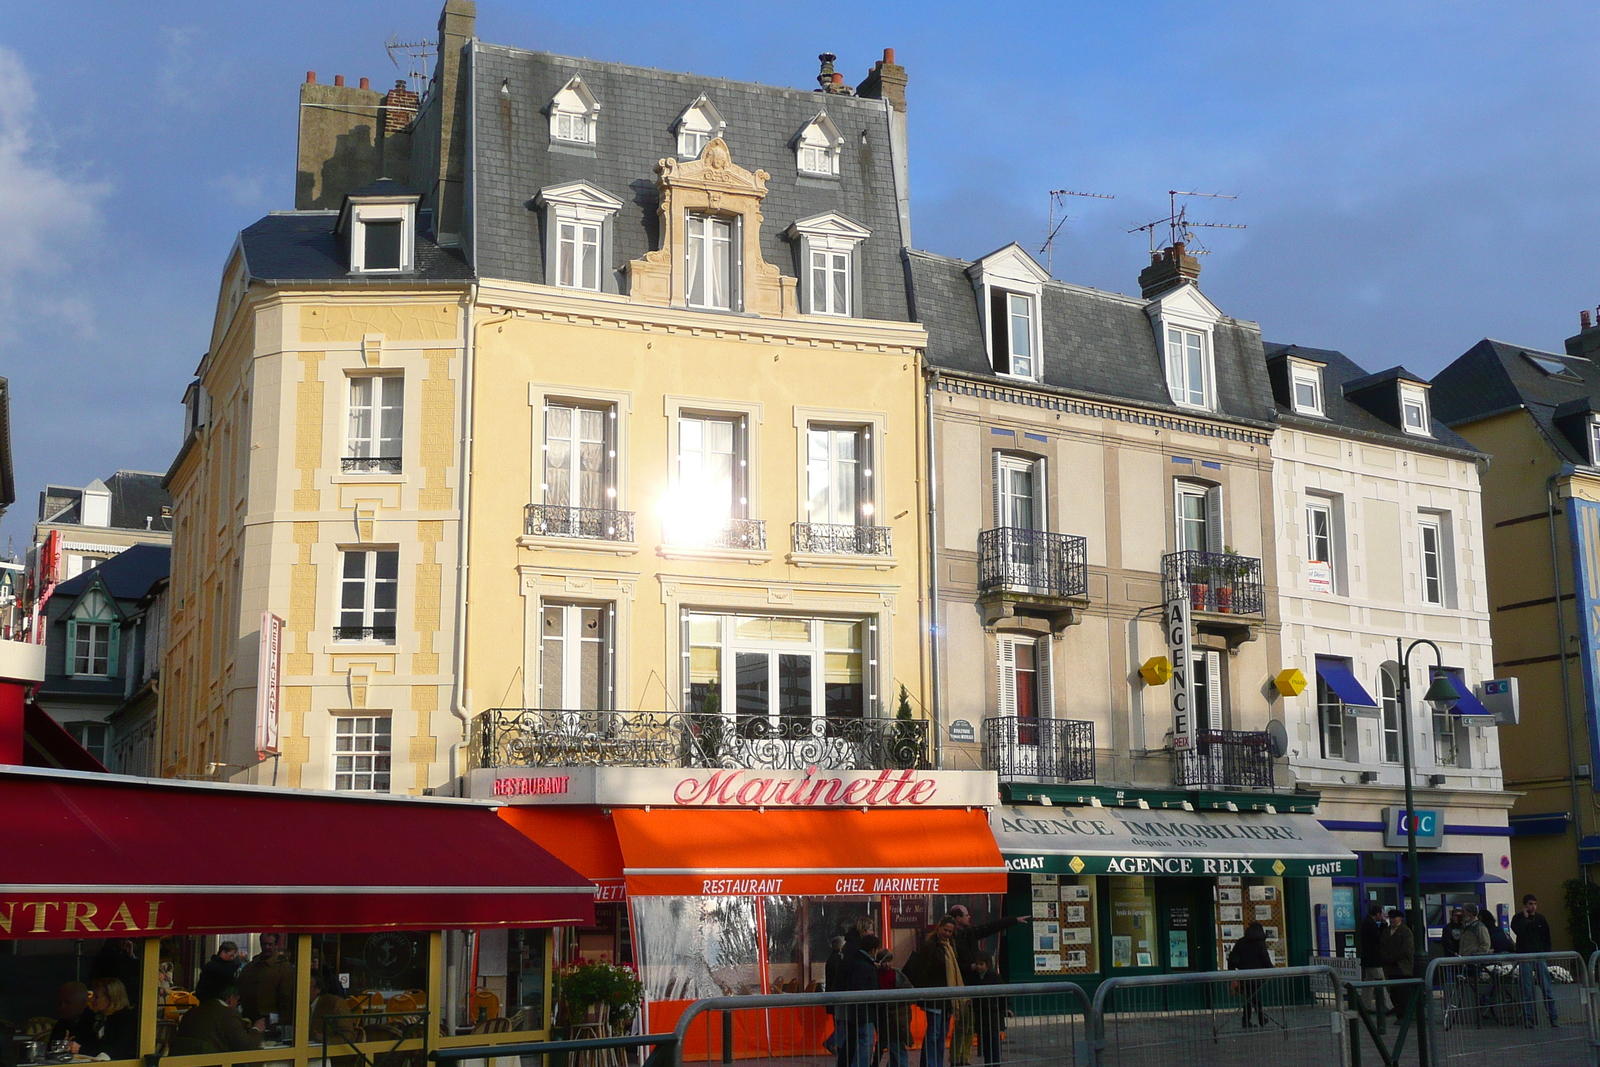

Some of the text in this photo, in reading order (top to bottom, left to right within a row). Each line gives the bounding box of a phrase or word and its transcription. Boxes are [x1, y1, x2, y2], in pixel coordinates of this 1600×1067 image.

[269, 622, 278, 720] RESTAURANT
[1170, 605, 1187, 735] AGENCE
[1487, 683, 1507, 693] CIC
[1174, 736, 1190, 749] REIX
[492, 776, 570, 797] RESTAURANT
[674, 765, 938, 806] Marinette
[1001, 817, 1304, 842] AGENCE IMMOBILIERE
[1401, 816, 1431, 832] CIC
[1131, 838, 1208, 849] depuis 1945
[1004, 856, 1045, 871] ACHAT
[1106, 857, 1193, 874] AGENCE
[1202, 858, 1256, 874] REIX
[1308, 861, 1342, 876] VENTE
[702, 877, 940, 895] RESTAURANT CHEZ MARINETTE
[0, 901, 175, 934] NTRAL
[1336, 906, 1351, 918] 6%
[1313, 958, 1357, 969] IMMOBILIER
